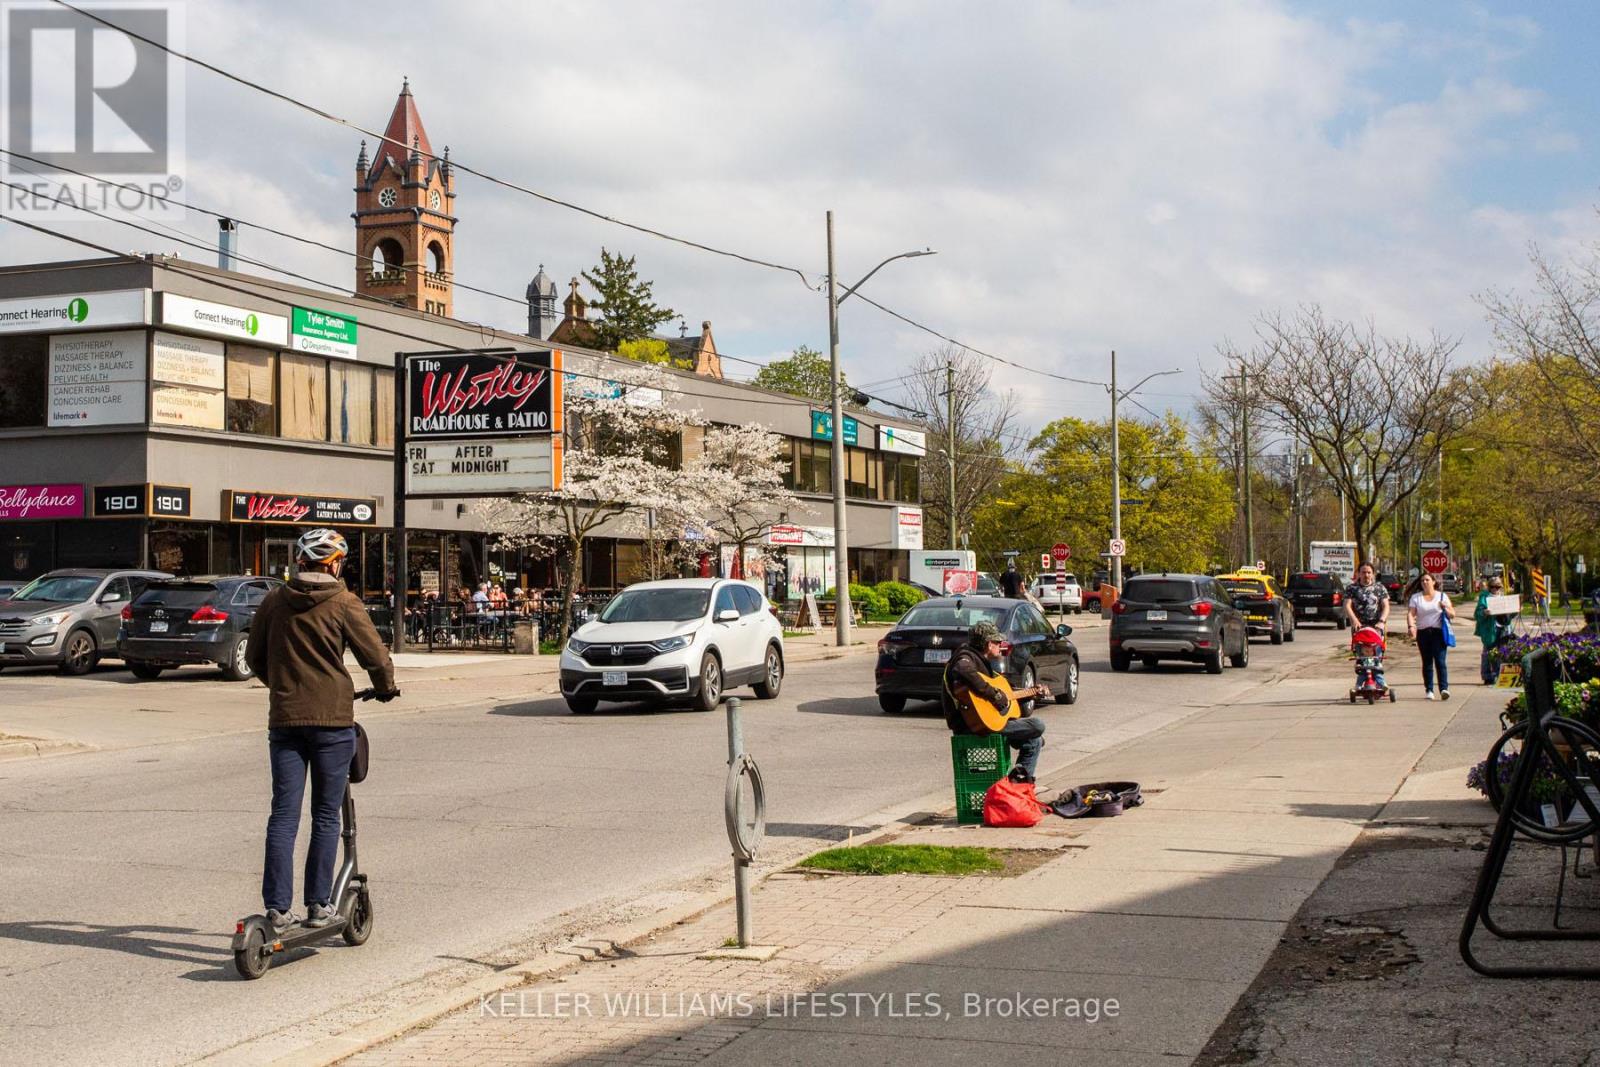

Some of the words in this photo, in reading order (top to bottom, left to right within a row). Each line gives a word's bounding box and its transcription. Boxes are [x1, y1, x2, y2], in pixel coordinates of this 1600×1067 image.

[31, 307, 68, 319] Hearing
[194, 309, 220, 323] Connect
[221, 314, 246, 330] Hearing
[307, 311, 324, 326] Tyler
[325, 315, 345, 329] Smith
[55, 340, 114, 351] PHYSIOTHERAPY
[55, 352, 89, 362] MASSAGE
[91, 350, 124, 361] THERAPY
[55, 362, 92, 373] DIZZINESS
[99, 360, 134, 371] BALANCE
[417, 359, 441, 372] The
[54, 374, 78, 384] PELVIC
[80, 373, 109, 382] HEALTH
[54, 386, 84, 396] CANCER
[85, 384, 110, 394] REHAB
[422, 354, 548, 421] Wortley
[53, 396, 101, 406] CONCUSSION
[102, 394, 122, 404] CARE
[53, 411, 80, 420] lifemark
[413, 413, 490, 432] ROADHOUSE
[494, 416, 503, 429] &
[508, 411, 548, 428] PATIO
[409, 447, 427, 460] FRI
[455, 445, 493, 459] AFTER
[412, 461, 435, 475] SAT
[451, 459, 510, 474] MIDNIGHT
[104, 496, 137, 510] 190
[156, 496, 182, 510] 190
[235, 495, 246, 505] THE
[247, 495, 310, 522] Wortley
[316, 502, 326, 510] LIVE
[326, 502, 341, 511] MUSIC
[337, 512, 351, 520] PATIO
[1053, 547, 1070, 556] STOP
[1423, 557, 1447, 567] STOP
